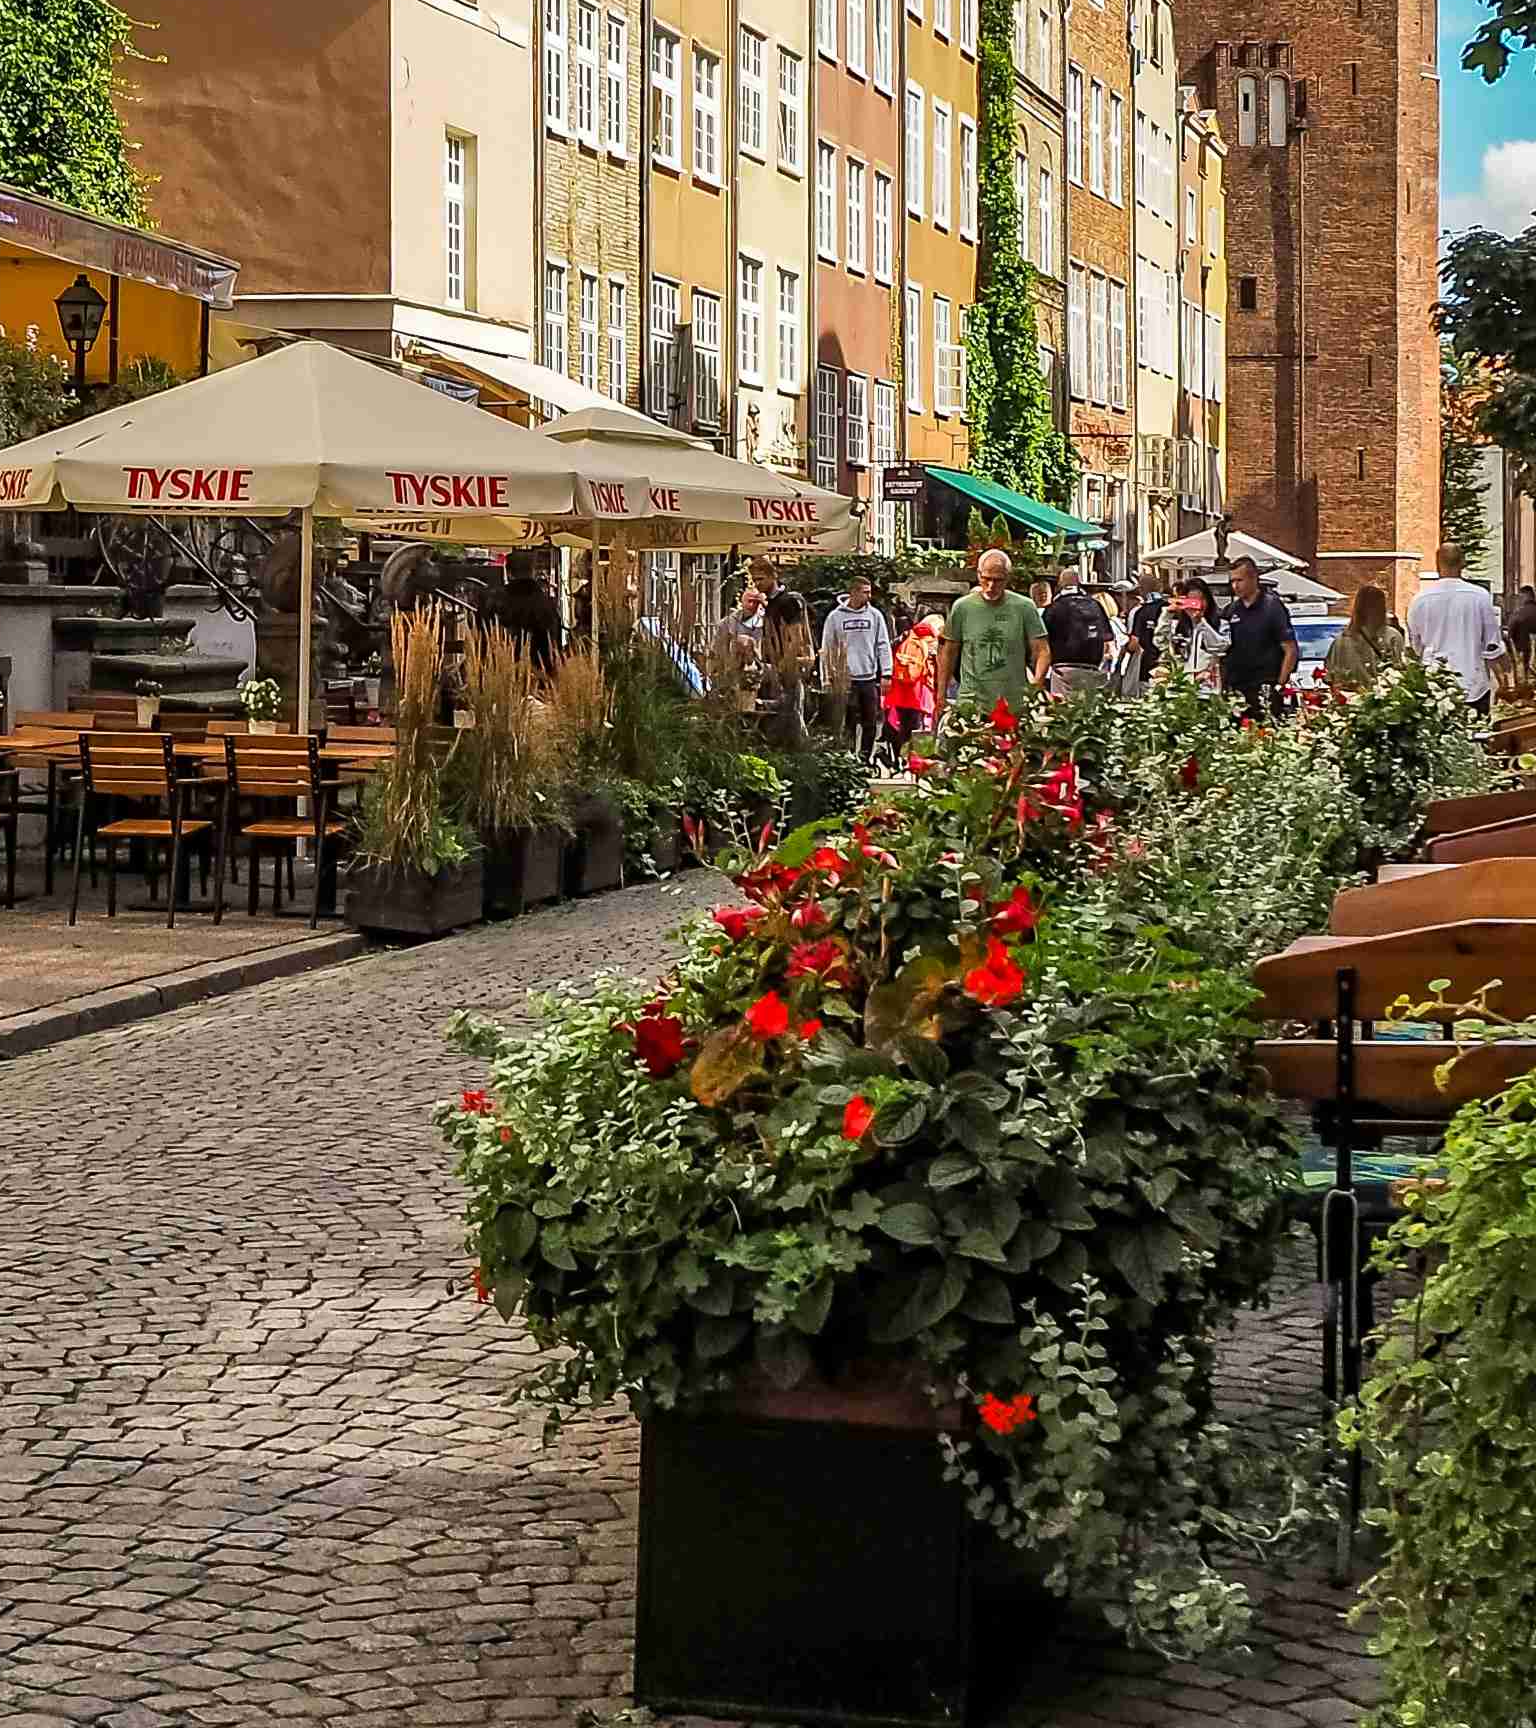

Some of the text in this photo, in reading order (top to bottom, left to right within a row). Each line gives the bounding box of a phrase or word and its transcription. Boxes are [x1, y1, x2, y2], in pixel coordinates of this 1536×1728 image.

[122, 466, 254, 502] TYSKIE
[385, 472, 510, 508] TYSKIE
[648, 487, 681, 512] KIE
[744, 496, 820, 522] TYSKIE
